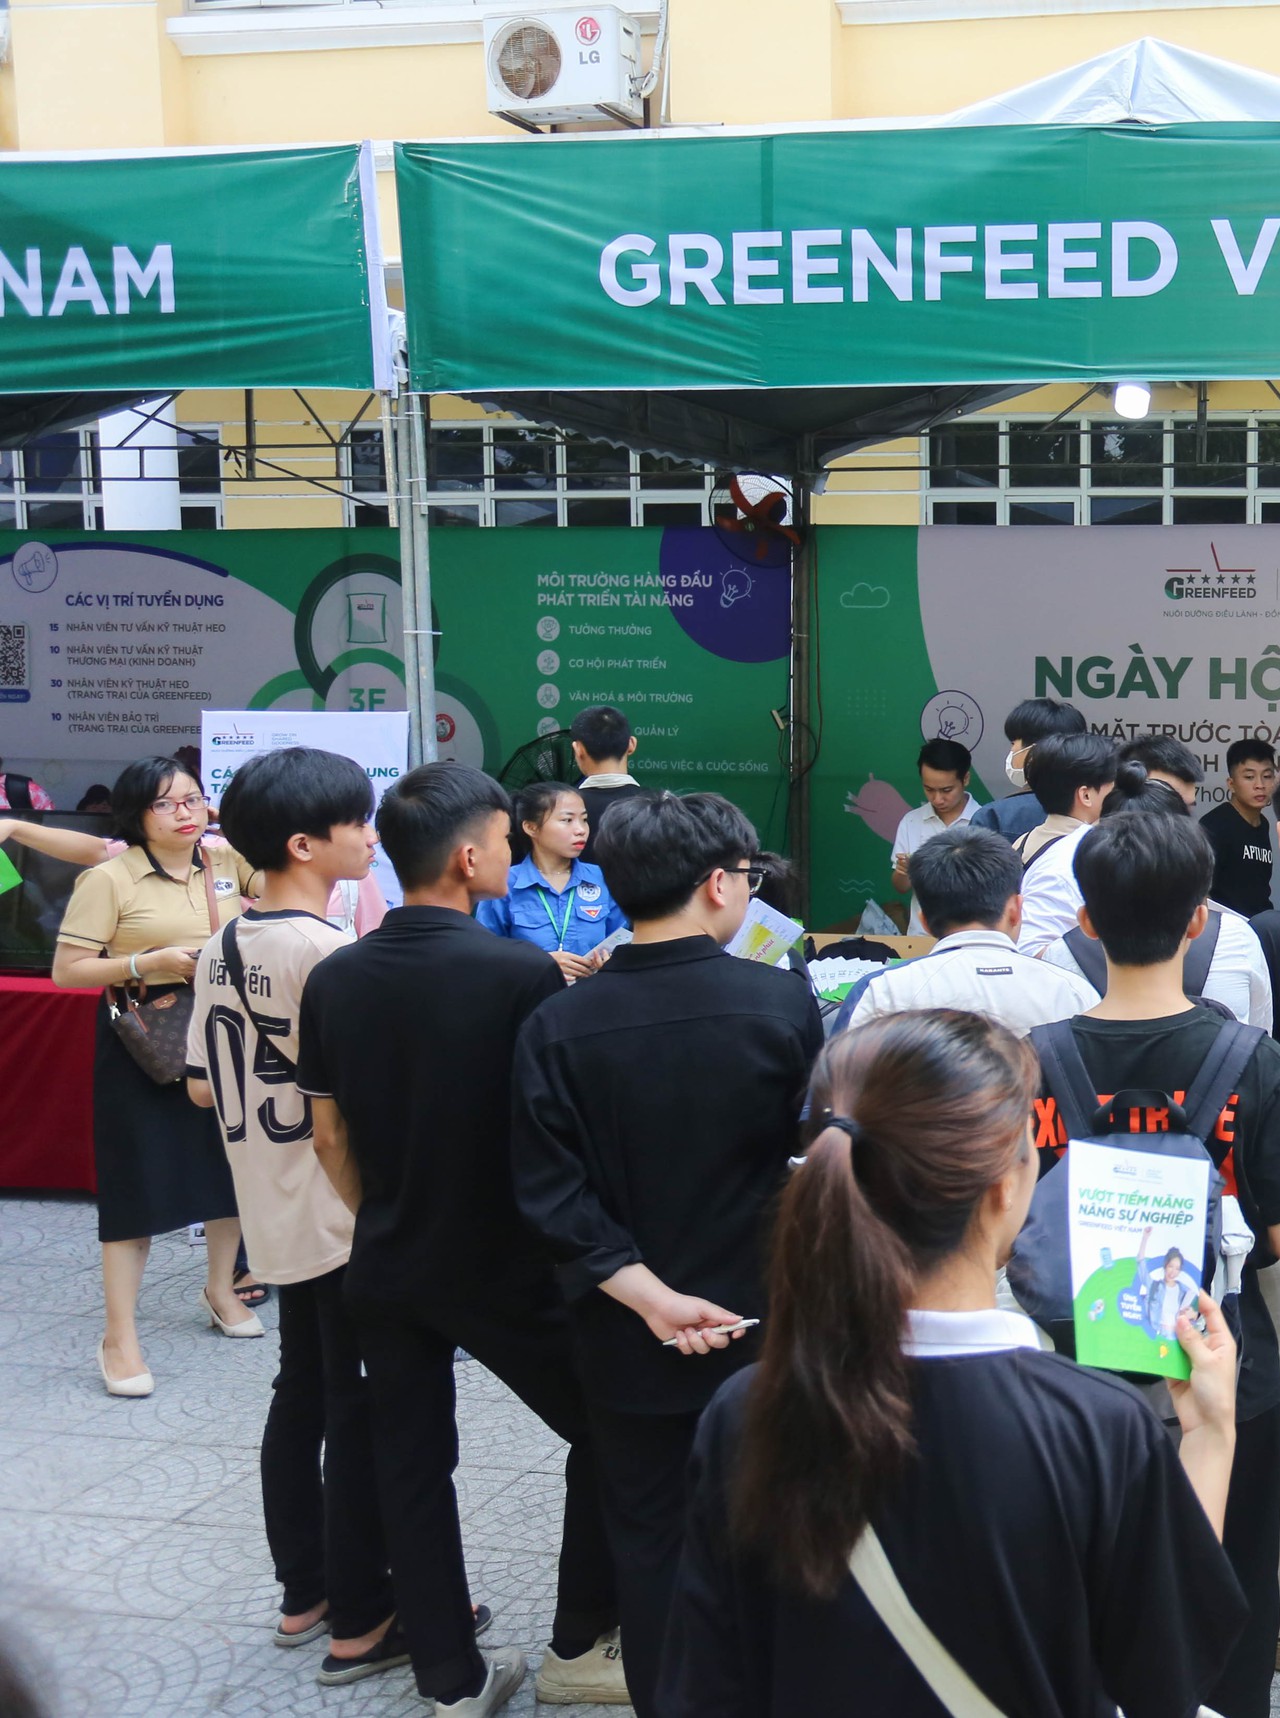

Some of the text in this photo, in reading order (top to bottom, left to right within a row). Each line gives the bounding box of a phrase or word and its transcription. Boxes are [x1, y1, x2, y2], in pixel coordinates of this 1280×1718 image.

[579, 51, 601, 65] LG
[598, 219, 1181, 309] GREENFEED
[0, 243, 175, 317] NAM
[537, 569, 713, 588] MÔI TRƯỜNG HÀNG ĐẦU
[1164, 576, 1257, 600] GREENFEED
[65, 589, 224, 610] CÁC VỊ TRÍ TUYỂN DỤNG
[537, 588, 694, 607] PHÁT TRIỂN TÀI NĂNG
[50, 623, 59, 632] 15
[66, 622, 94, 632] NHÂN
[96, 622, 118, 632] VIÊN
[206, 624, 226, 632] HEO
[50, 646, 60, 654] 10
[66, 644, 94, 654] NHÂN
[96, 644, 118, 654] VIÊN
[129, 657, 155, 667] (KINH
[157, 657, 196, 668] DOANH)
[568, 656, 667, 670] CƠ HỘI PHÁT TRIỂN
[1035, 643, 1194, 701] NGÀY
[51, 680, 62, 688] 30
[67, 677, 95, 688] NHÂN
[97, 678, 119, 688] VIÊN
[169, 680, 189, 689] HEO
[67, 690, 104, 700] (TRANG
[152, 691, 212, 701] GREENFEED)
[349, 688, 386, 711] 3F
[568, 691, 590, 701] VĂN
[627, 691, 647, 703] MÔI
[649, 691, 694, 704] TRƯỜNG
[51, 713, 61, 721] 10
[68, 711, 96, 721] NHÂN
[97, 711, 120, 722] VIÊN
[69, 724, 105, 734] (TRANG
[153, 725, 202, 735] GREENFEE
[634, 723, 665, 736] QUẢN
[1146, 719, 1231, 744] TRƯỚC
[211, 736, 254, 746] GREENFEED
[637, 758, 668, 770] CÔNG
[670, 759, 694, 772] VIỆC
[706, 760, 736, 772] CUỘC
[738, 759, 769, 772] SỐNG
[211, 766, 400, 780] CÁ ỤNG
[1078, 1187, 1116, 1205] VƯỢT
[1151, 1194, 1195, 1210] NĂNG
[1078, 1202, 1116, 1219] NÂNG
[1139, 1210, 1194, 1228] NGHIỆP
